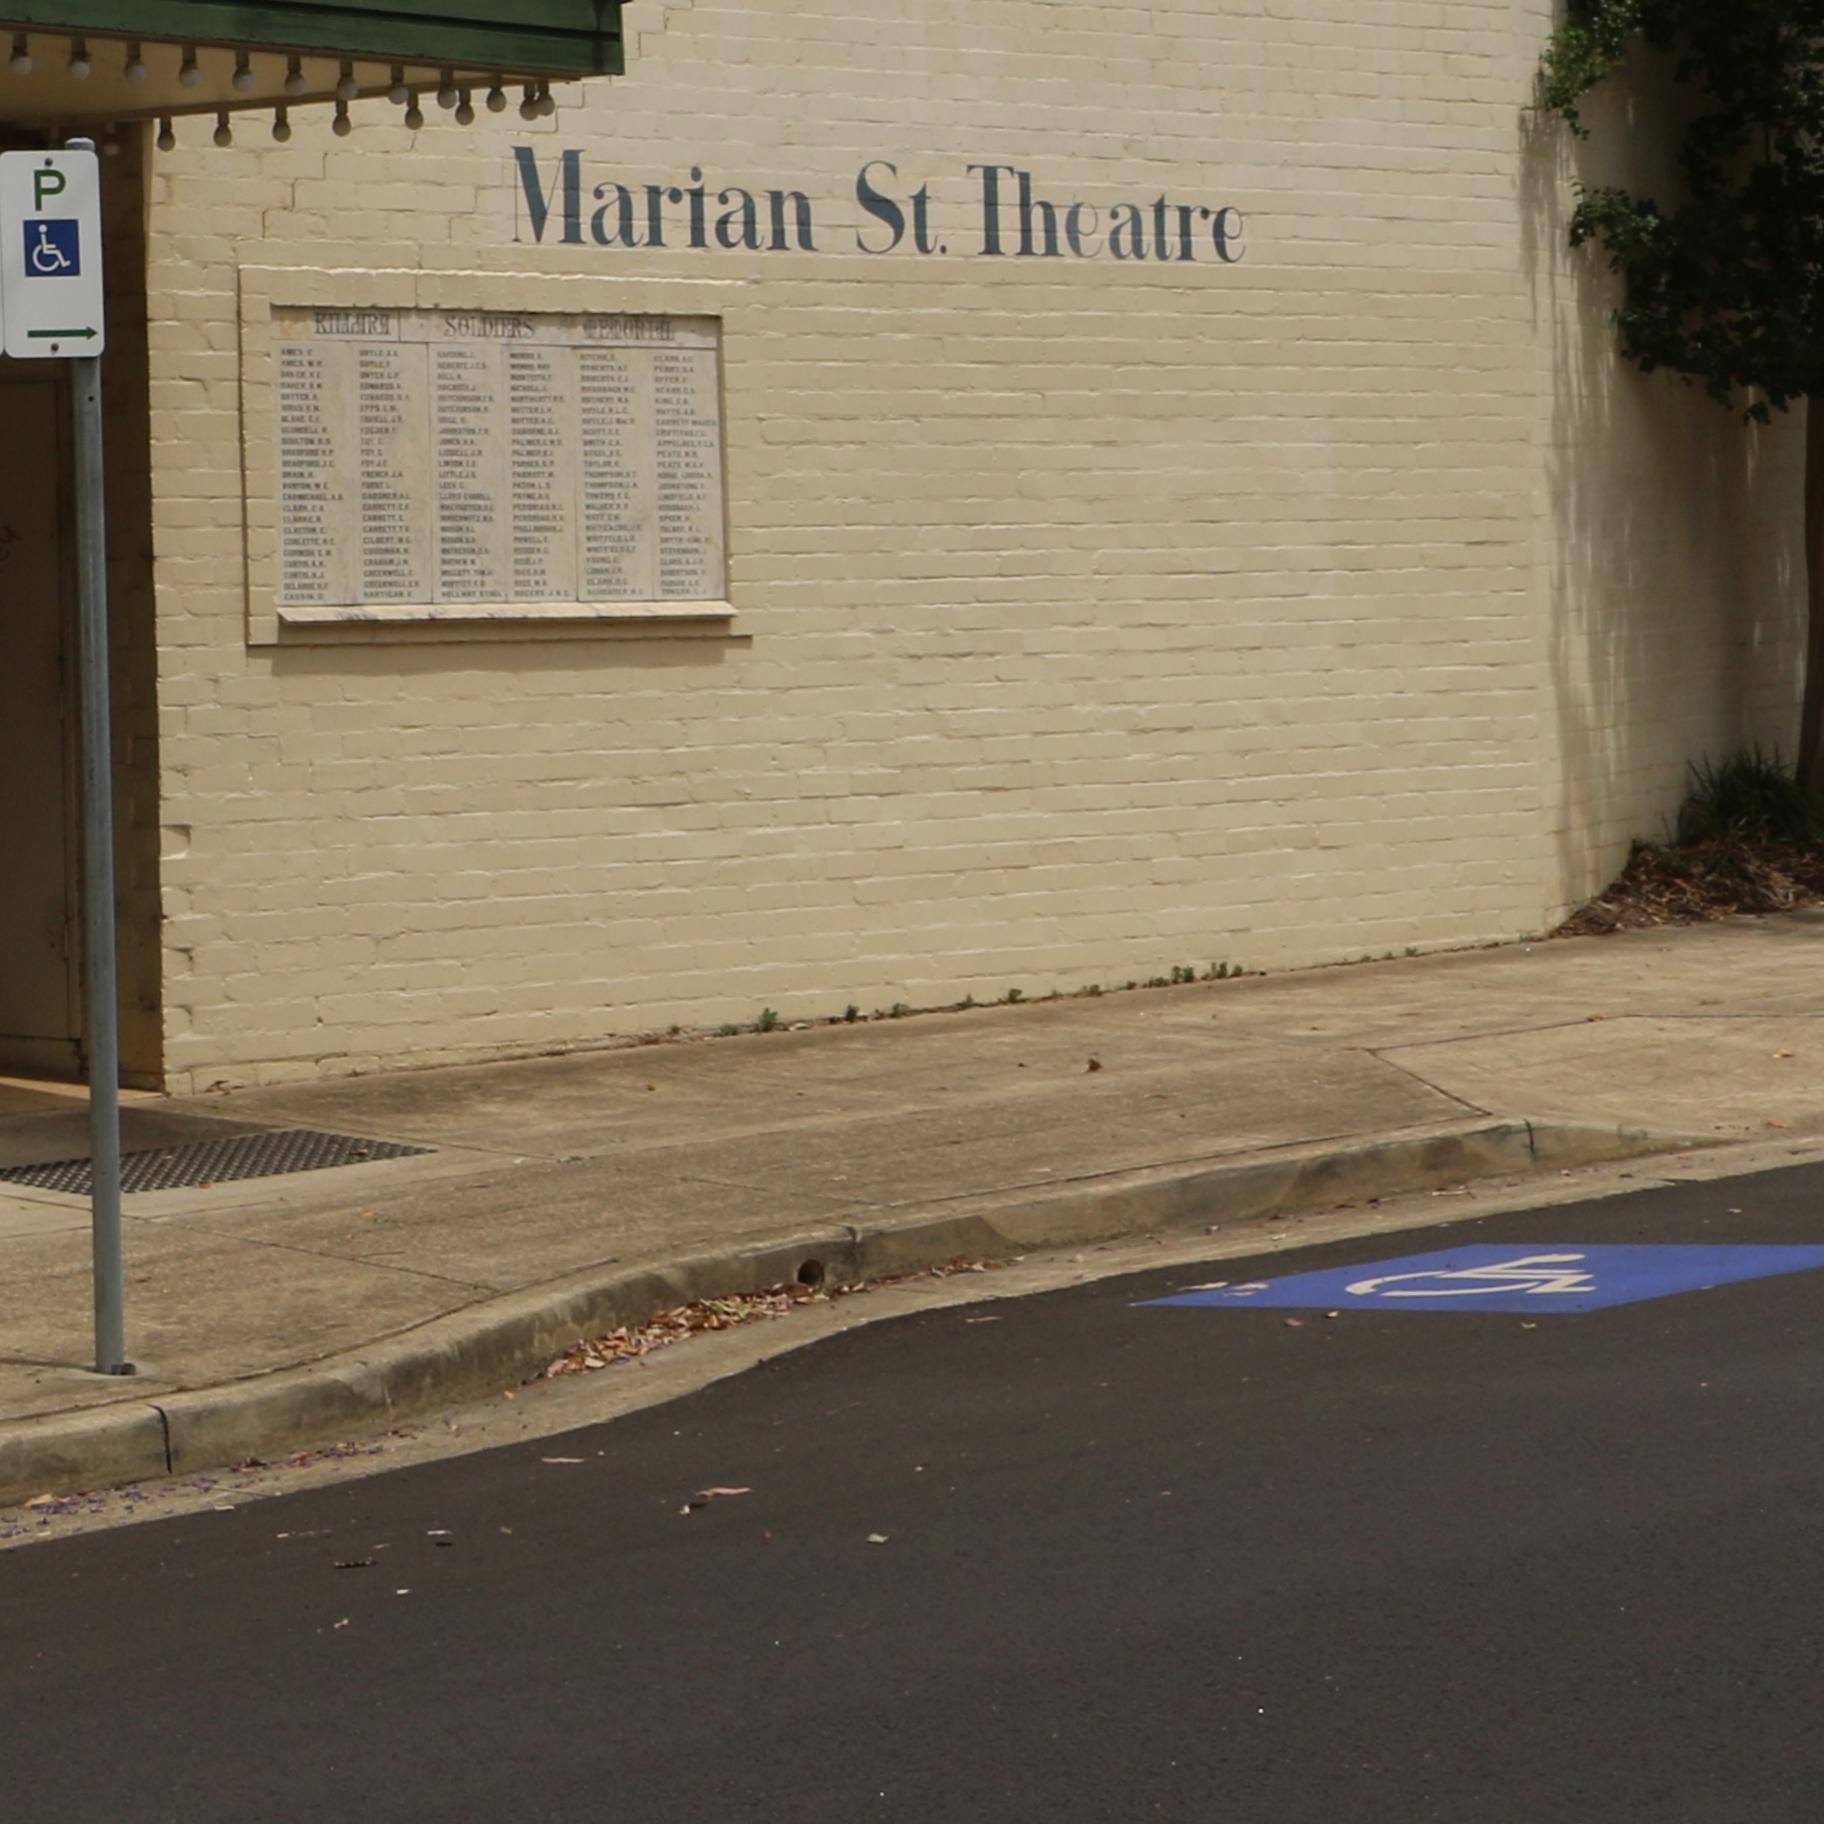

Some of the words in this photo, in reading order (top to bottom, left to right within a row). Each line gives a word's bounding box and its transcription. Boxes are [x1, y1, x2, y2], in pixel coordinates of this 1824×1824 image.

[34, 170, 66, 211] P
[512, 146, 819, 252] Marian
[856, 160, 947, 255] St.
[967, 164, 1247, 264] Theatre
